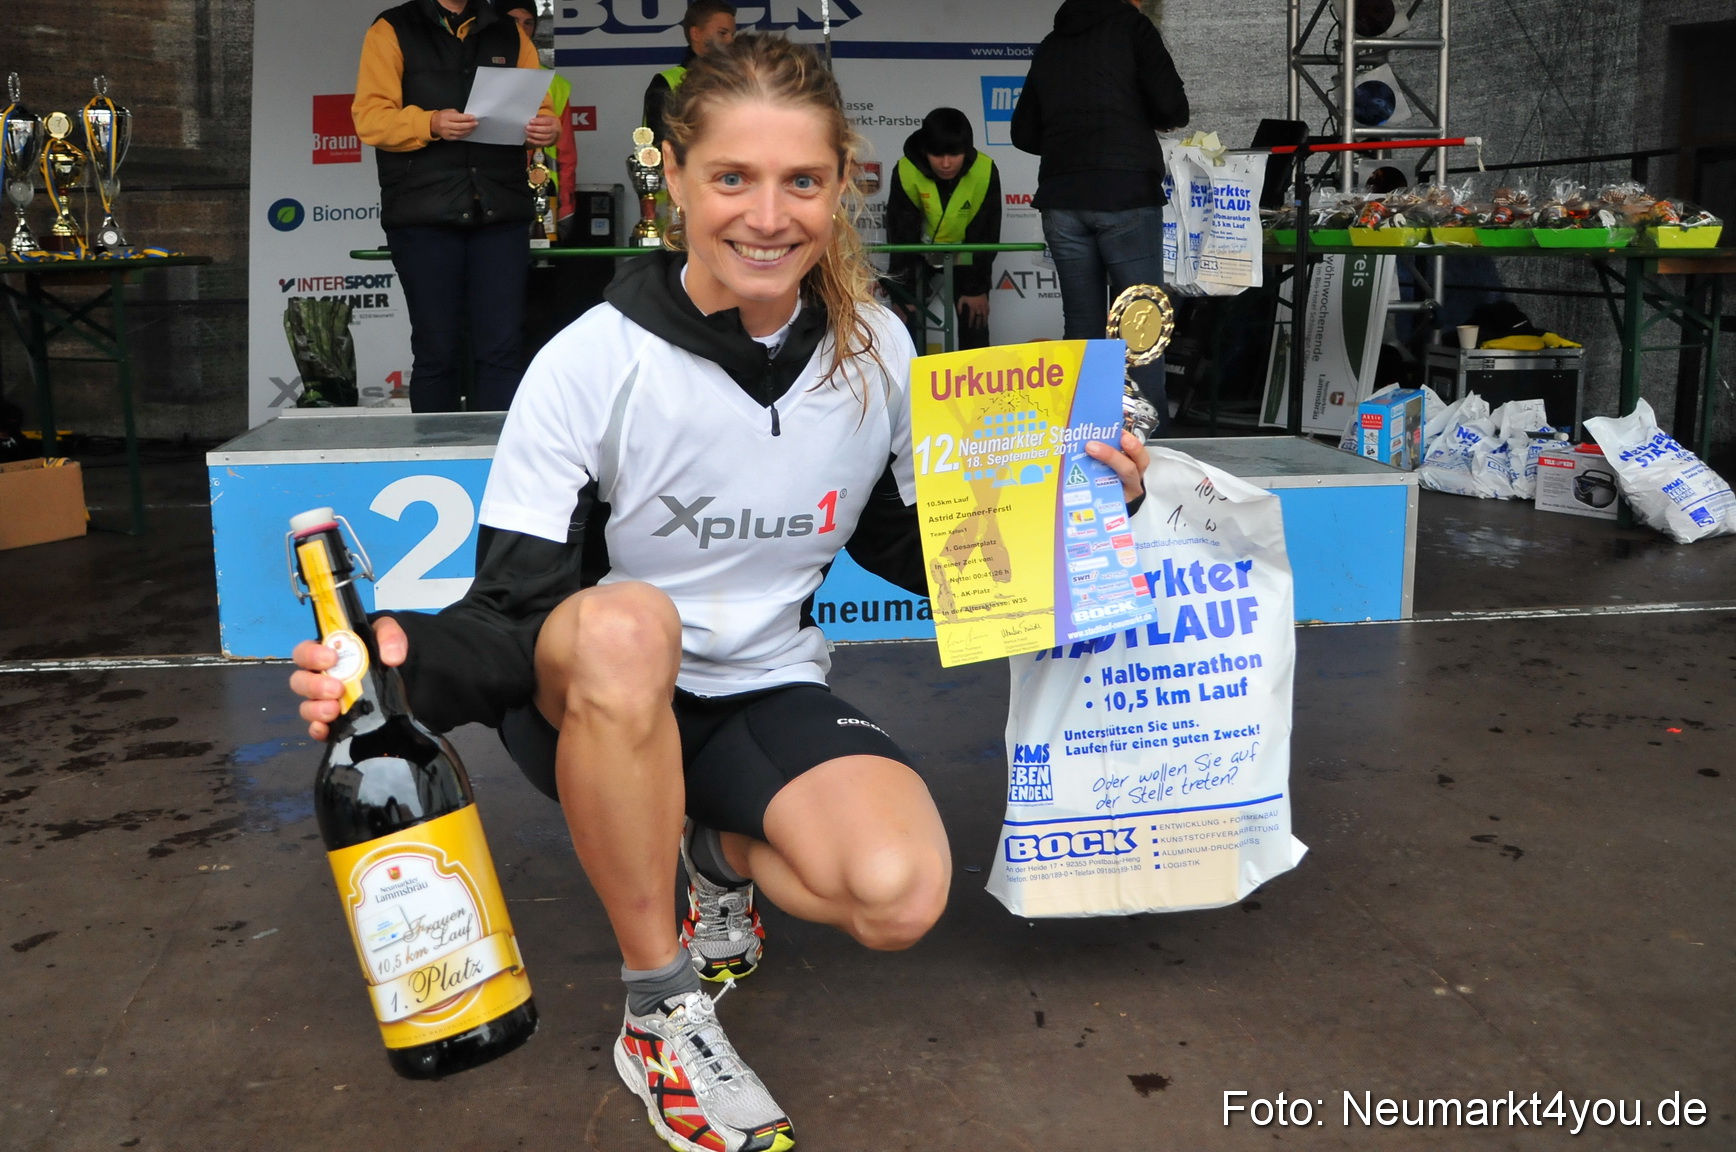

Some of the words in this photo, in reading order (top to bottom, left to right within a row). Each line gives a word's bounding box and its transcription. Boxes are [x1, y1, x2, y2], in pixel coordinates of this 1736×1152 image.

[971, 46, 1034, 57] www.bock
[844, 101, 874, 111] asse
[991, 87, 1023, 110] ma
[571, 112, 590, 126] K
[312, 133, 358, 151] Braun
[1005, 193, 1033, 205] MA
[1213, 184, 1251, 198] arkter
[312, 202, 380, 222] Bionori
[297, 274, 394, 292] INTERSPORT
[1312, 254, 1335, 362] wöhnwochenende
[931, 358, 1064, 401] Urkunde
[915, 434, 960, 475] 12.
[958, 430, 1046, 457] Neumarkter
[1049, 422, 1119, 444] Stadtlauf
[966, 457, 983, 468] 18.
[987, 447, 1050, 466] September
[1053, 442, 1079, 455] 2011
[1194, 476, 1228, 504] 10,
[927, 499, 952, 508] 10.5km
[651, 490, 839, 549] Xplus1
[928, 513, 954, 523] Astrid
[956, 505, 1012, 519] Zunner-Ferstl
[368, 474, 475, 610] 2
[930, 530, 947, 538] Team
[953, 539, 997, 551] Gesamtplatz
[943, 560, 962, 569] einer
[962, 558, 977, 566] Zeit
[1144, 558, 1253, 598] rkter
[960, 588, 991, 598] AK-Platz
[1012, 597, 1028, 605] W35
[817, 598, 932, 625] neuma
[1073, 600, 1137, 623] BOCK
[1101, 653, 1263, 687] Halbmarathon
[1104, 688, 1149, 713] 10,5
[1156, 685, 1191, 706] km
[1200, 677, 1249, 701] Lauf
[1064, 723, 1144, 741] Unterstützen
[1148, 721, 1170, 732] Sie
[1173, 719, 1200, 731] uns.
[1065, 741, 1108, 756] Laufen
[1110, 737, 1129, 752] für
[1132, 736, 1168, 750] einen
[1172, 732, 1210, 749] guten
[1214, 723, 1260, 741] Zweck!
[1013, 743, 1050, 763] KMS
[1010, 766, 1050, 785] EBEN
[1092, 774, 1130, 792] Oder
[1138, 763, 1188, 784] wollen
[1193, 751, 1222, 773] Sie
[1230, 741, 1260, 764] auf
[1010, 785, 1053, 800] ENDEN
[1095, 794, 1121, 811] der
[1127, 782, 1174, 806] Stelle
[1180, 766, 1239, 795] treten?
[1159, 818, 1220, 831] ENTWICKLUNG
[1229, 809, 1279, 824] FORMENBAU
[1160, 823, 1280, 843] KUNSTSTOFFVERARBEITUNG
[1005, 827, 1138, 863] BOCK
[1161, 837, 1260, 857] ALUMINIUM-DRUCKGUSS
[1015, 863, 1026, 873] der
[1027, 861, 1047, 872] Heide
[1049, 862, 1058, 870] 17
[1066, 859, 1087, 868] 92353
[1162, 859, 1200, 869] LOGISTIK
[379, 876, 419, 894] Neumarkter
[1006, 874, 1028, 883] Telefon:
[1029, 870, 1069, 881] 09180/189-0
[1074, 869, 1095, 877] Telefax
[374, 881, 429, 904] Lammsbräu
[403, 907, 468, 943] Frauen
[377, 955, 402, 976] 10,5
[404, 946, 429, 965] km
[433, 912, 474, 951] Lauf
[390, 992, 408, 1013] 1.
[408, 955, 485, 1004] Platz
